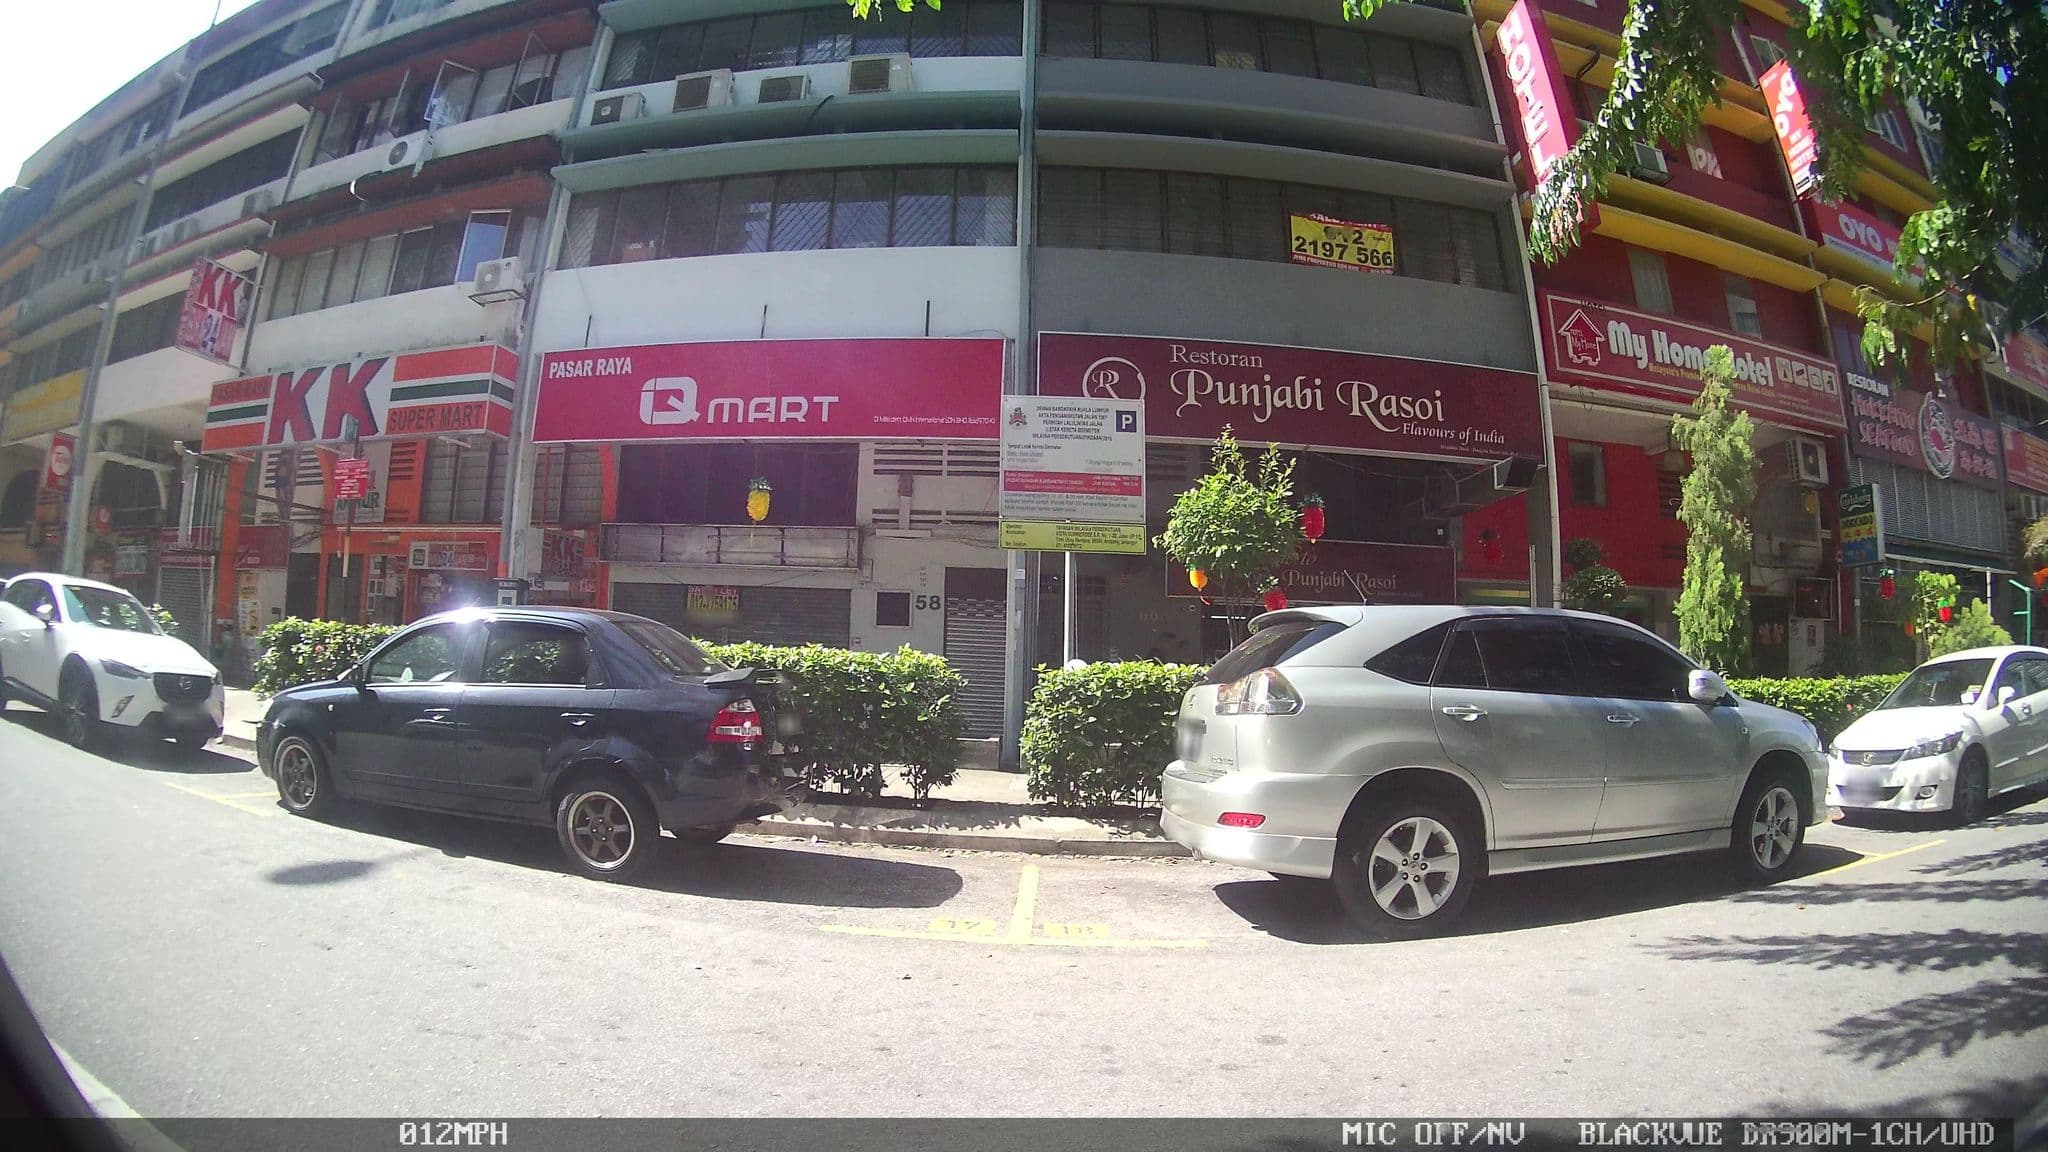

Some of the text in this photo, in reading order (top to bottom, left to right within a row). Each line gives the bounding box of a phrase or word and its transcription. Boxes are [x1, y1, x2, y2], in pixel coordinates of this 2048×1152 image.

[1499, 8, 1556, 178] HOTEL
[1839, 213, 1882, 252] OYO
[1294, 235, 1393, 267] 2197 566
[198, 262, 243, 320] KK
[1169, 344, 1263, 368] Restoran
[1607, 319, 1649, 369] My
[1727, 347, 1774, 387] otel
[549, 356, 633, 379] PASAR RAYA
[267, 357, 391, 444] KK
[707, 395, 839, 423] MART
[1169, 368, 1445, 433] Punjabi Rasoi
[389, 404, 484, 431] SUPER MART
[1121, 414, 1133, 430] P
[1402, 421, 1505, 446] Flavours of India
[1840, 493, 1872, 512] Carlsberg
[1282, 569, 1397, 595] Punjabi Rasoi
[915, 594, 941, 611] 58
